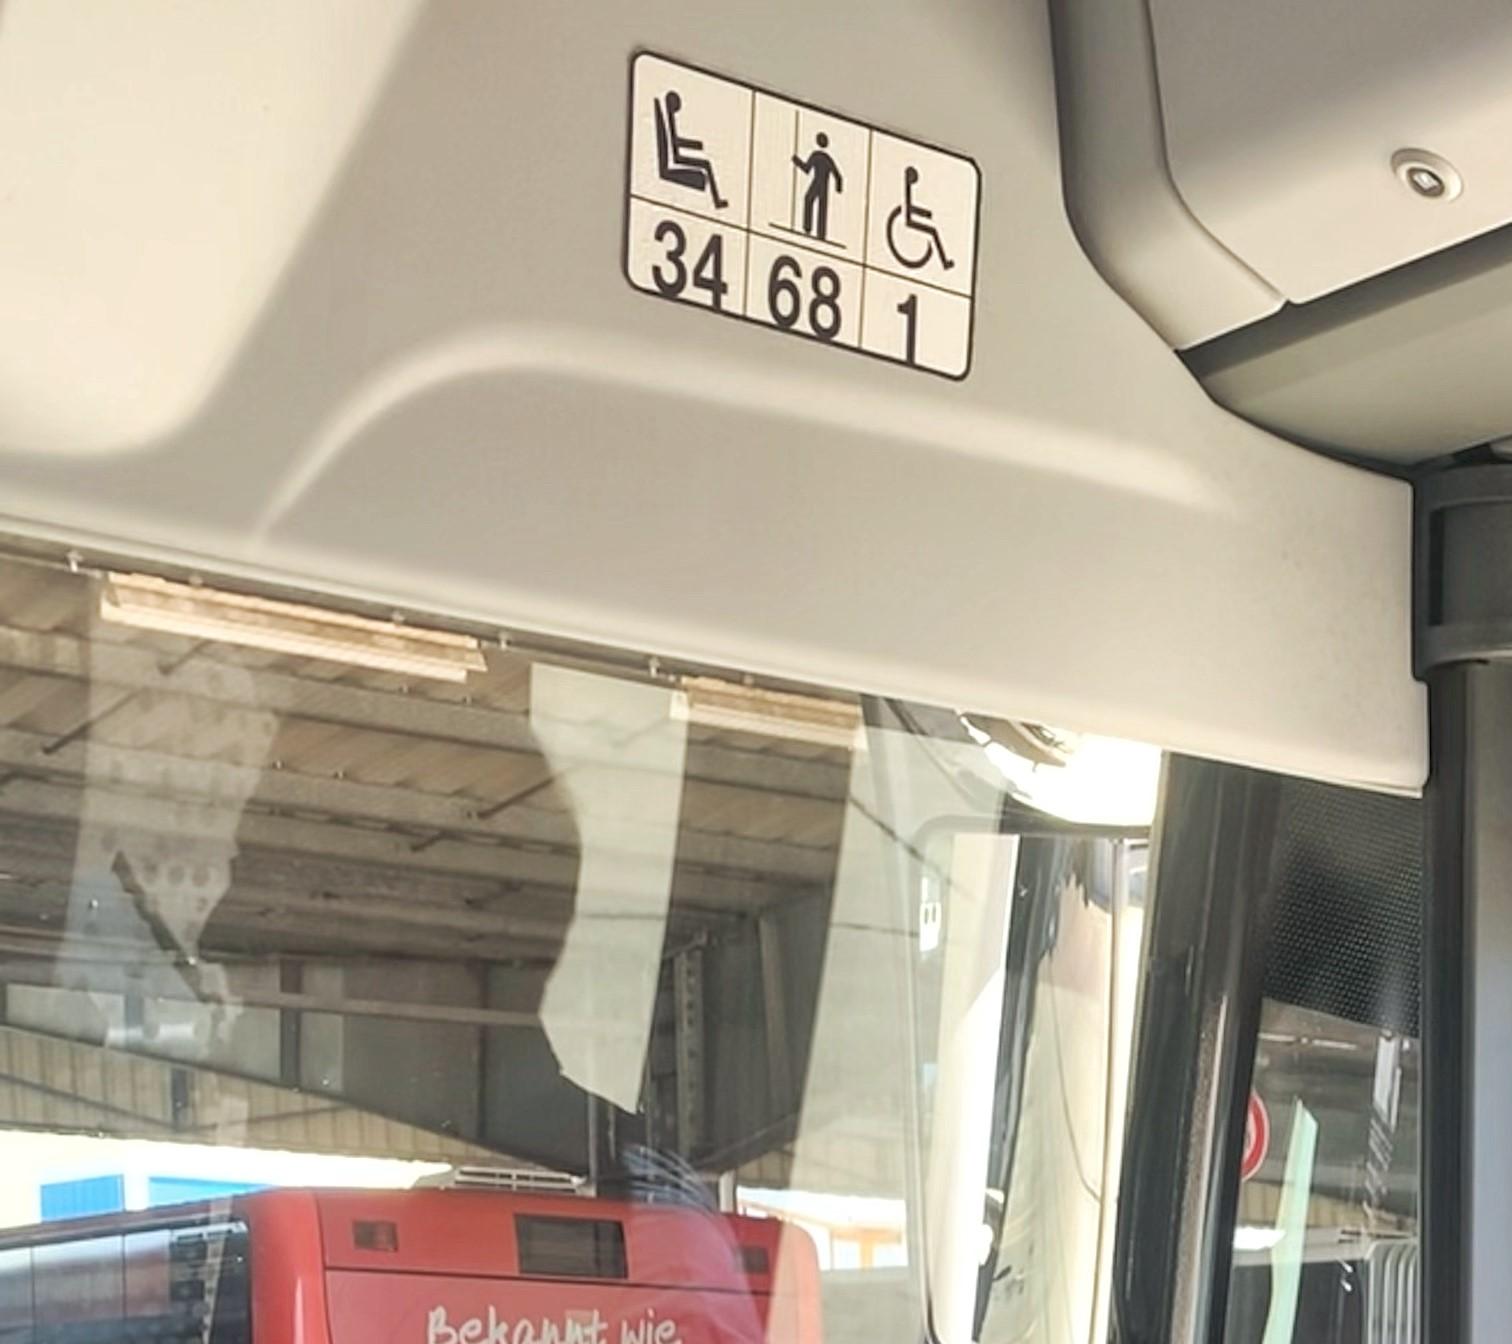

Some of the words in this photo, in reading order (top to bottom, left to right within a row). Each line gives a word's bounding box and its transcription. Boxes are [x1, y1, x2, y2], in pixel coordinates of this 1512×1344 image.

[651, 220, 729, 311] 34
[767, 254, 842, 341] 68
[896, 293, 918, 364] 1
